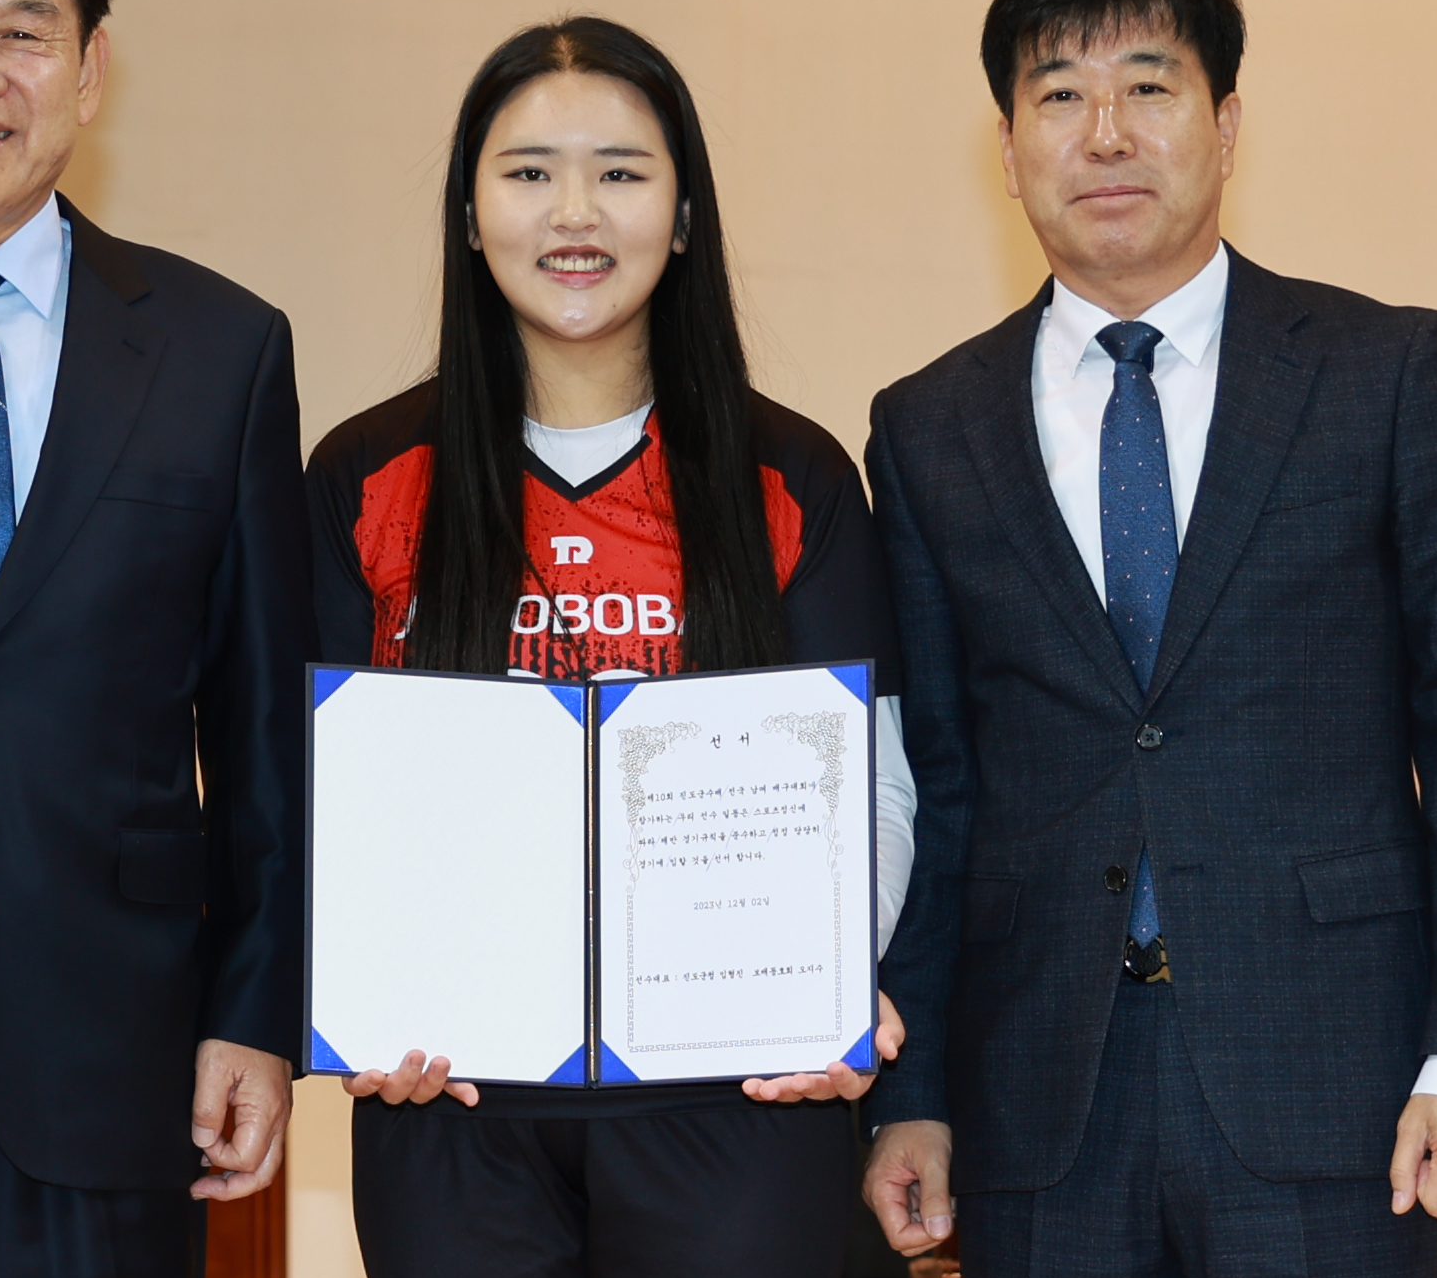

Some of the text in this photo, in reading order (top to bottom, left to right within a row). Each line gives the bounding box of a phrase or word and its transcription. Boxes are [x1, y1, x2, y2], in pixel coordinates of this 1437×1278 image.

[510, 593, 685, 636] OBOB
[647, 792, 673, 802] 제10회
[679, 788, 722, 800] 진도군수배
[728, 785, 745, 796] 전국
[750, 784, 766, 795] 남여
[639, 803, 806, 825] 참가하는 우리 선수 일동은 스포츠정신에
[638, 837, 655, 847] 따라
[661, 835, 677, 845] 제반
[683, 831, 726, 844] 경기규칙을
[731, 829, 766, 840] 준수하고
[794, 824, 820, 836] 당당히
[638, 851, 765, 869] 경기에 임할 것을 선서 합니다.
[693, 896, 770, 911] 2023년 12월 02일
[636, 974, 670, 985] 선수대표
[682, 970, 715, 982] 진도군청
[798, 964, 824, 974] 오지수
